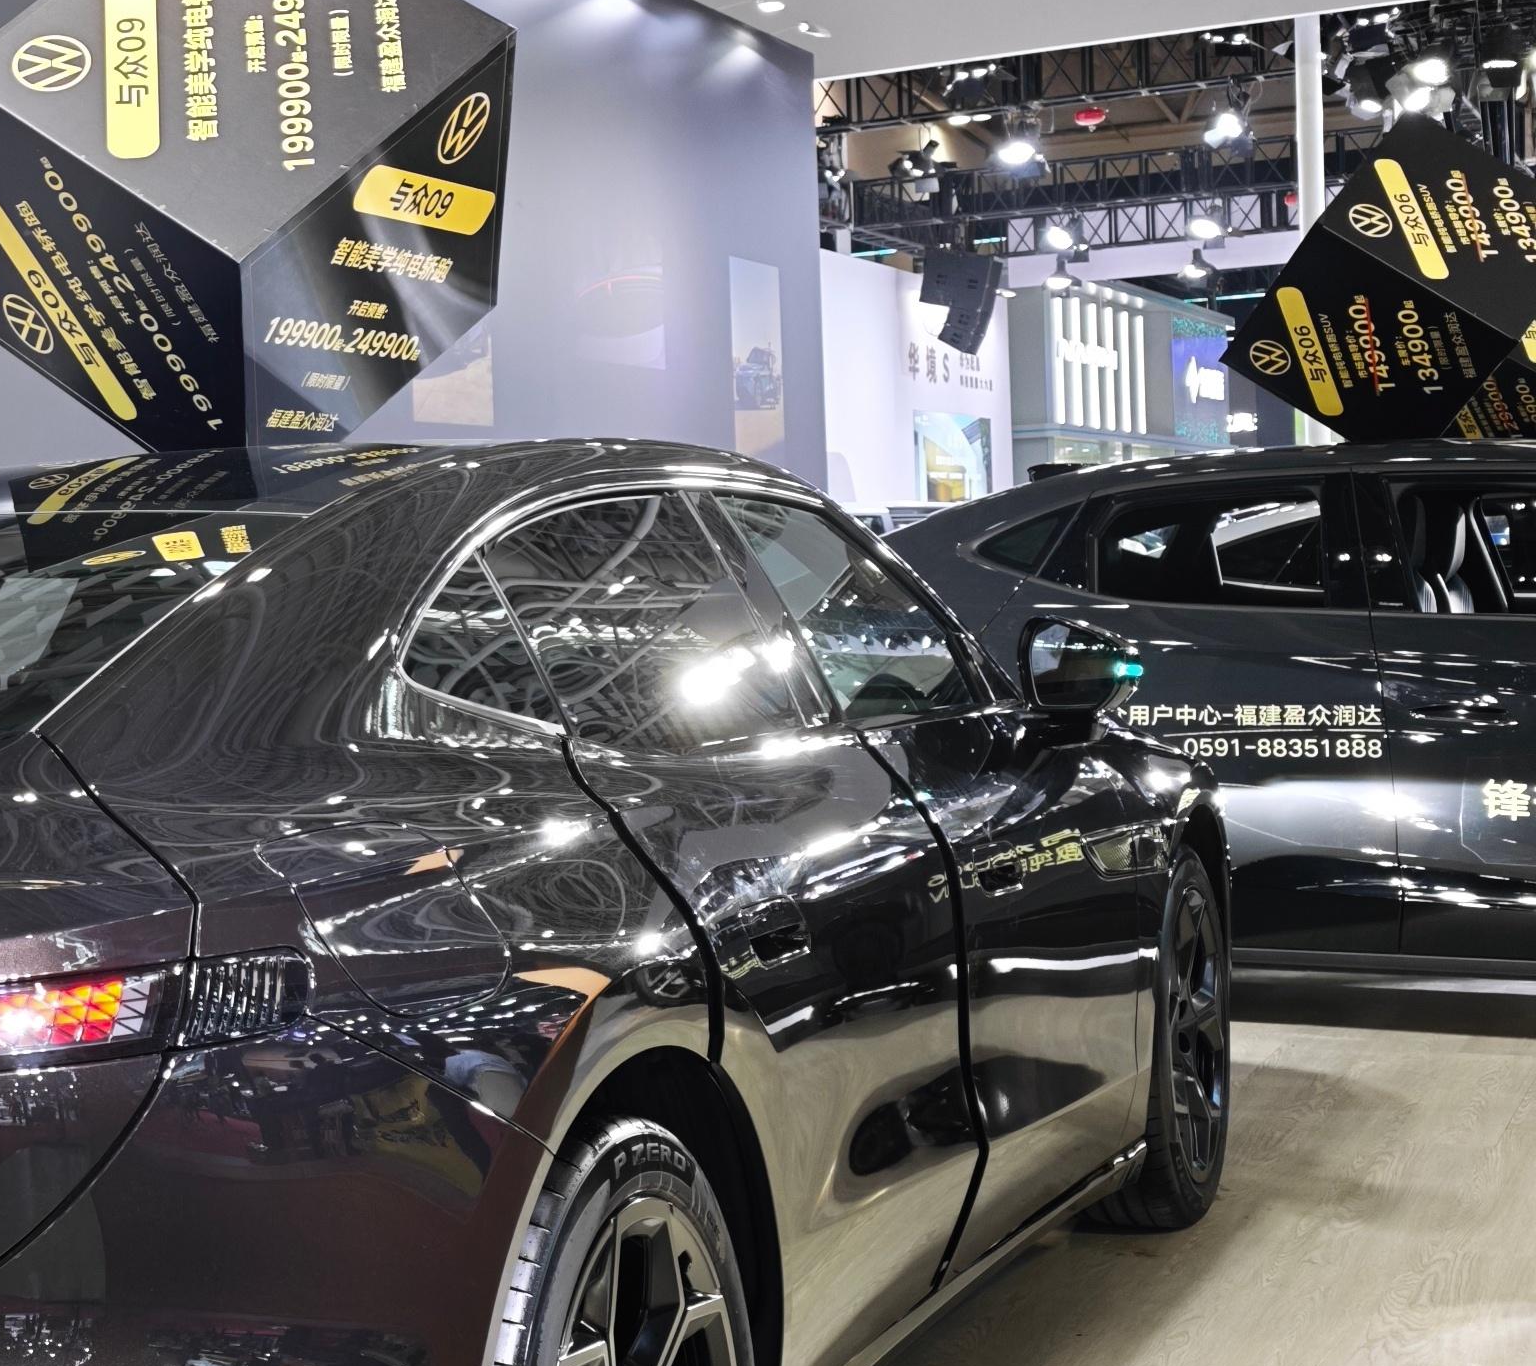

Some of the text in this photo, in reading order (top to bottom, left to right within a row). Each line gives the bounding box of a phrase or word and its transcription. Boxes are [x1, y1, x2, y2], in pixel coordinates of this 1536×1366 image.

[115, 17, 150, 108] 与众09
[389, 178, 454, 219] 与众09
[1394, 193, 1429, 247] 与众06
[330, 236, 454, 283] 智能美学纯电轿跑
[16, 200, 157, 400] 智能美学纯电轿跑
[26, 269, 100, 367] 与众09
[1294, 325, 1327, 383] 与众06
[266, 408, 340, 431] 福建盈众润达
[1183, 737, 1383, 759] 0591-88351888
[1482, 778, 1536, 822] 锋
